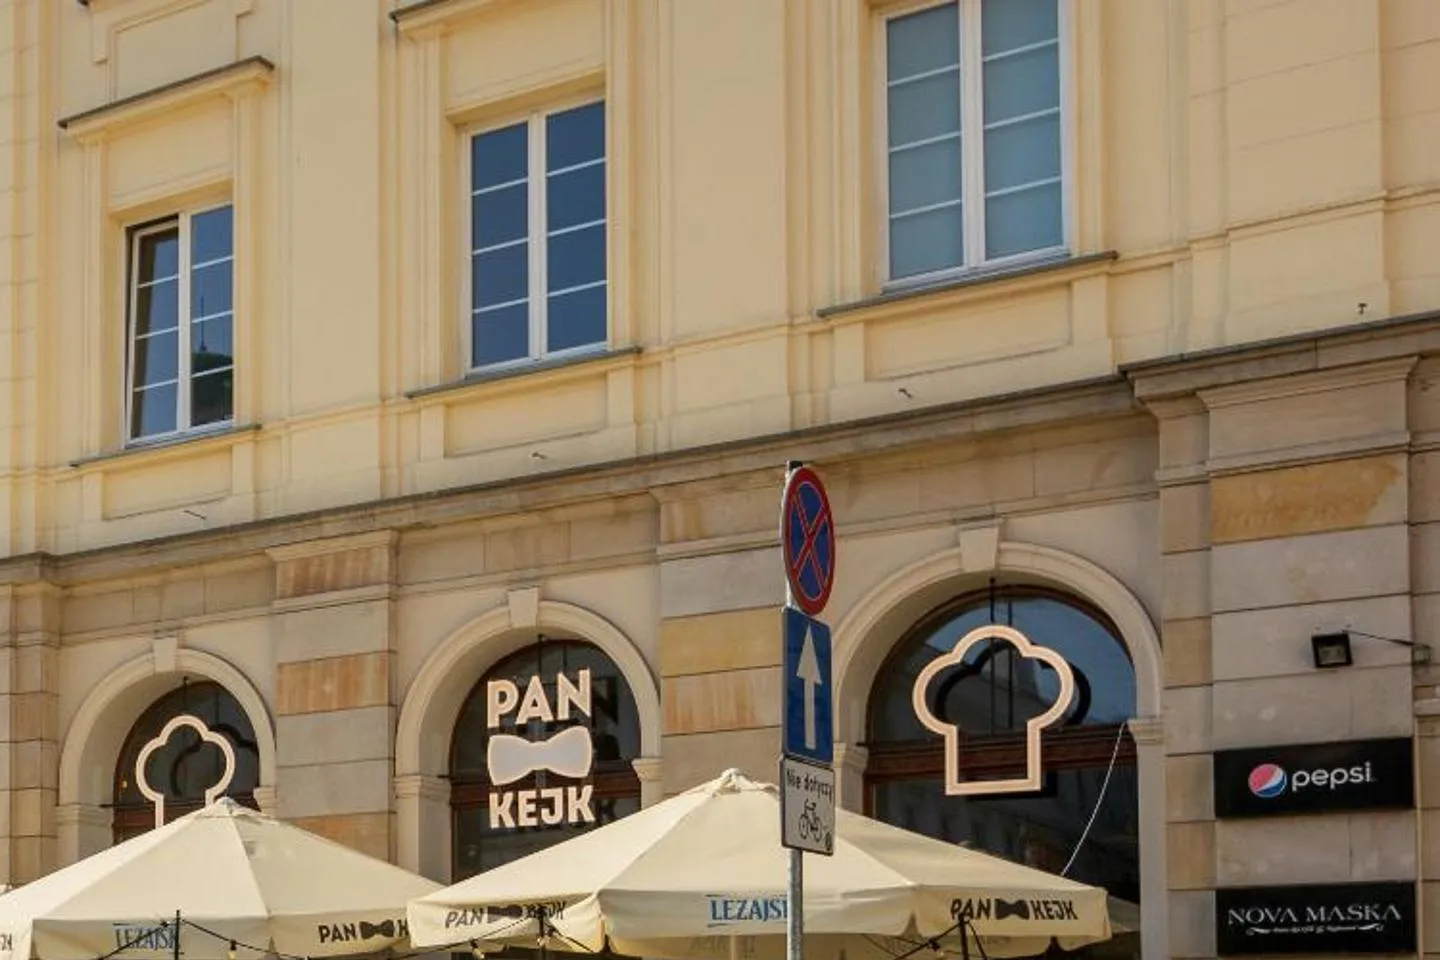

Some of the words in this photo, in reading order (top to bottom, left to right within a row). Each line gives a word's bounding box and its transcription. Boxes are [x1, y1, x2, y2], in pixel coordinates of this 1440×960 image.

[487, 668, 592, 729] PAN
[786, 767, 801, 790] Nie
[804, 772, 833, 804] dotyczy
[1291, 761, 1372, 792] pepsi
[488, 785, 596, 829] KEJK
[445, 906, 485, 929] PAN
[950, 898, 991, 920] PAN
[1030, 899, 1078, 920] KEJK
[1228, 907, 1298, 925] NOVA
[1306, 903, 1402, 922] MASKA
[318, 918, 358, 944] PAN
